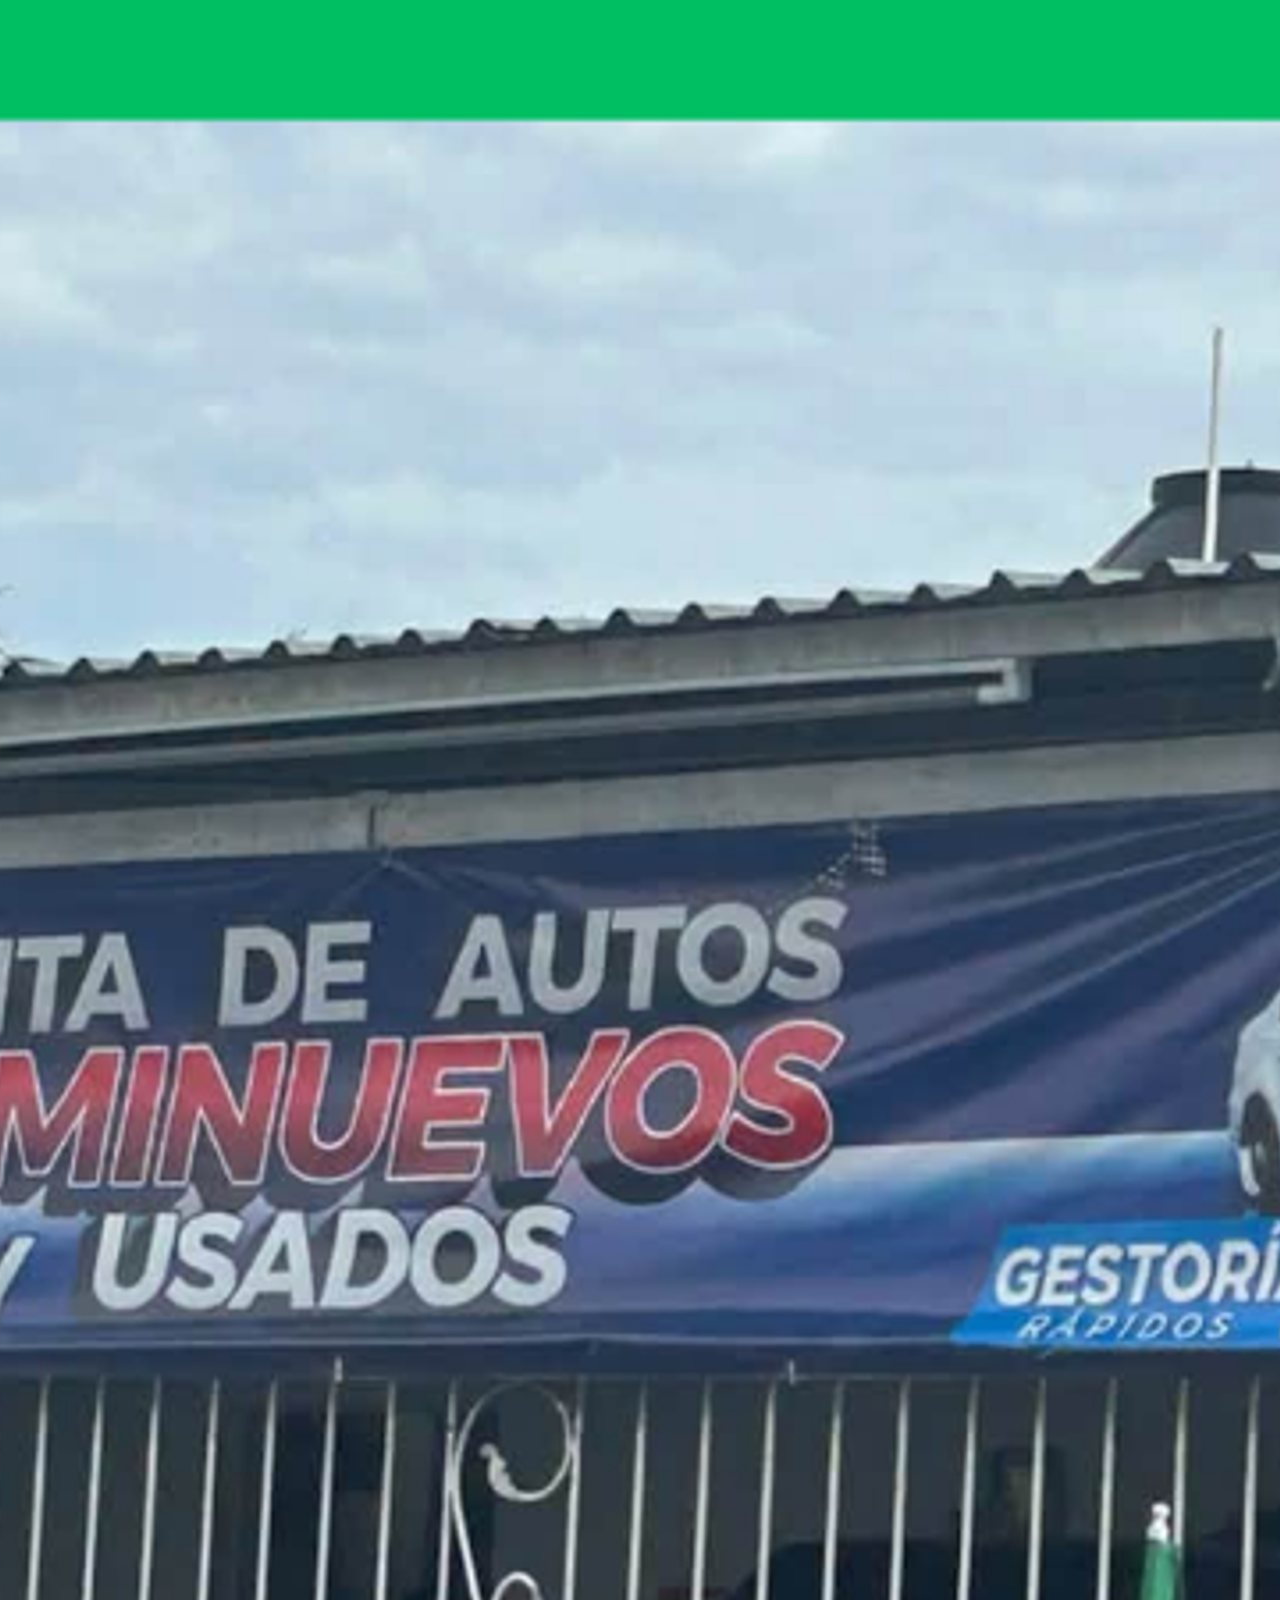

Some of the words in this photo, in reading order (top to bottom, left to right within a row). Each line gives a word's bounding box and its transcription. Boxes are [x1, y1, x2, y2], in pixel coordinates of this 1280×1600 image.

[217, 921, 372, 1029] DE
[433, 896, 846, 1020] AUTOS
[93, 1205, 574, 1311] USADOS
[1018, 1305, 1232, 1342] RÁPIDOS
